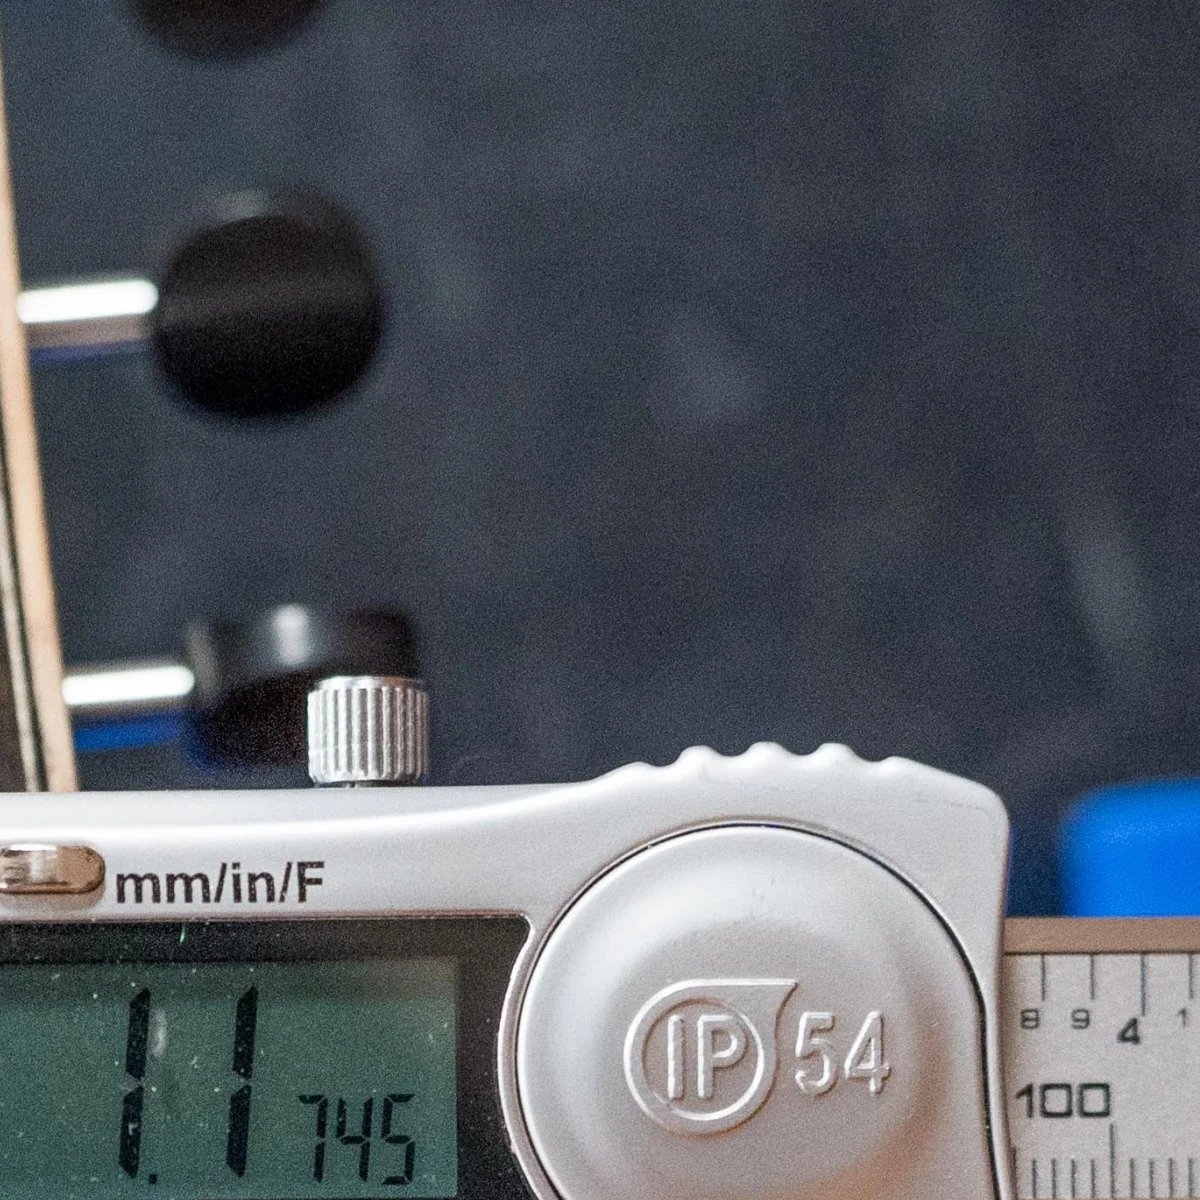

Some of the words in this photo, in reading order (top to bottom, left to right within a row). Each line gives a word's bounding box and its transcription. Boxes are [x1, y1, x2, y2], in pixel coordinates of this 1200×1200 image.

[115, 860, 325, 905] mm/in/F
[1021, 1009, 1039, 1028] 8
[1072, 1009, 1090, 1029] 9
[1117, 1017, 1141, 1045] 4
[666, 1012, 749, 1100] IP
[794, 1011, 891, 1096] 54
[1016, 1083, 1110, 1118] 100
